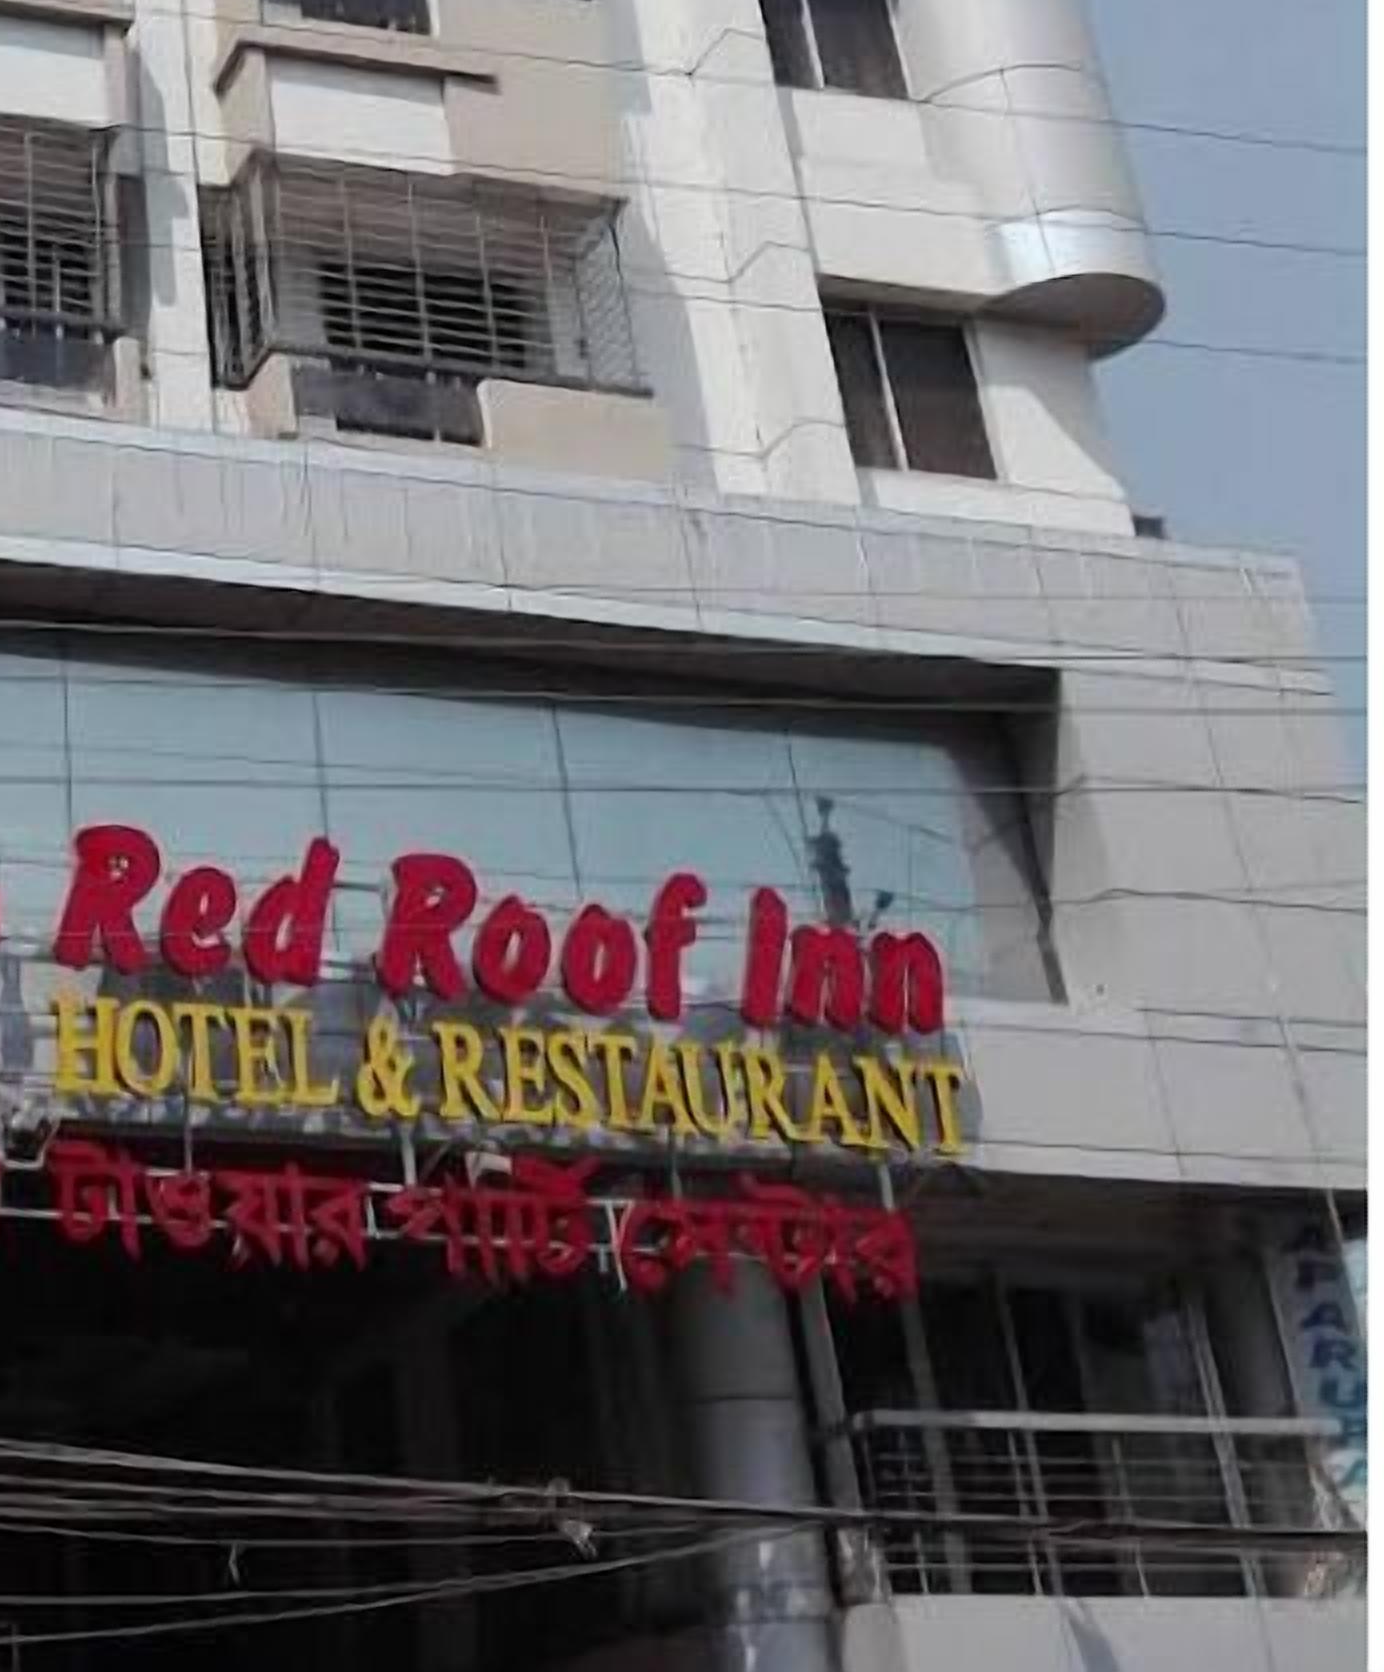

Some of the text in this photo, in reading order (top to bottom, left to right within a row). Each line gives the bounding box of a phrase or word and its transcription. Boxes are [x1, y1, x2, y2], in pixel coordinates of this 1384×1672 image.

[54, 824, 948, 1036] Red Roof Inn
[50, 992, 342, 1106] HOTEL
[356, 1016, 422, 1122] &
[430, 1020, 970, 1160] RESTAURANT
